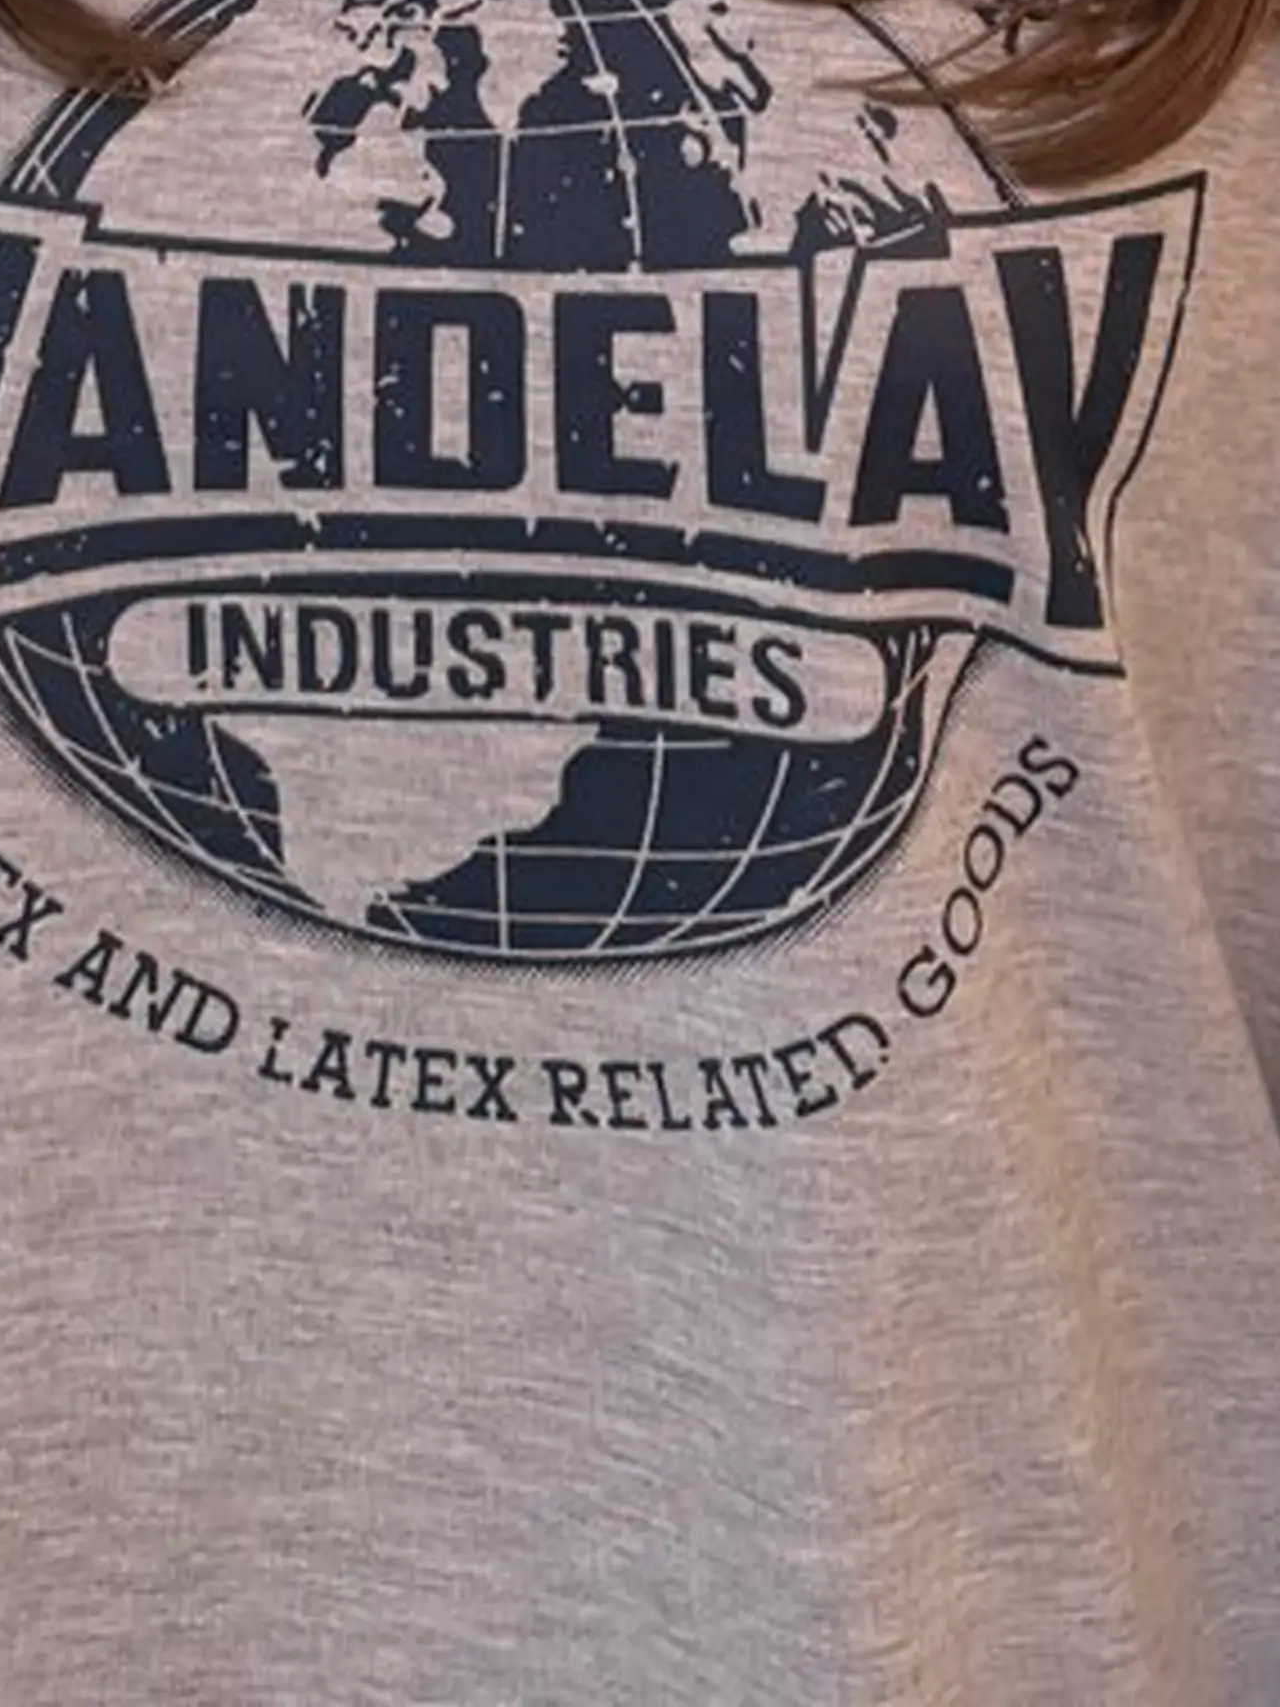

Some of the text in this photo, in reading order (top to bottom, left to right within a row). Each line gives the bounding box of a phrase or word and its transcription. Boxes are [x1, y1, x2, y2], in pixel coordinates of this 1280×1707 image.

[183, 600, 810, 726] INDUSTRIES
[53, 928, 241, 1054] AND
[257, 1016, 518, 1121] LATEX
[541, 1011, 891, 1131] RELATED
[896, 734, 1081, 1020] GOODS
